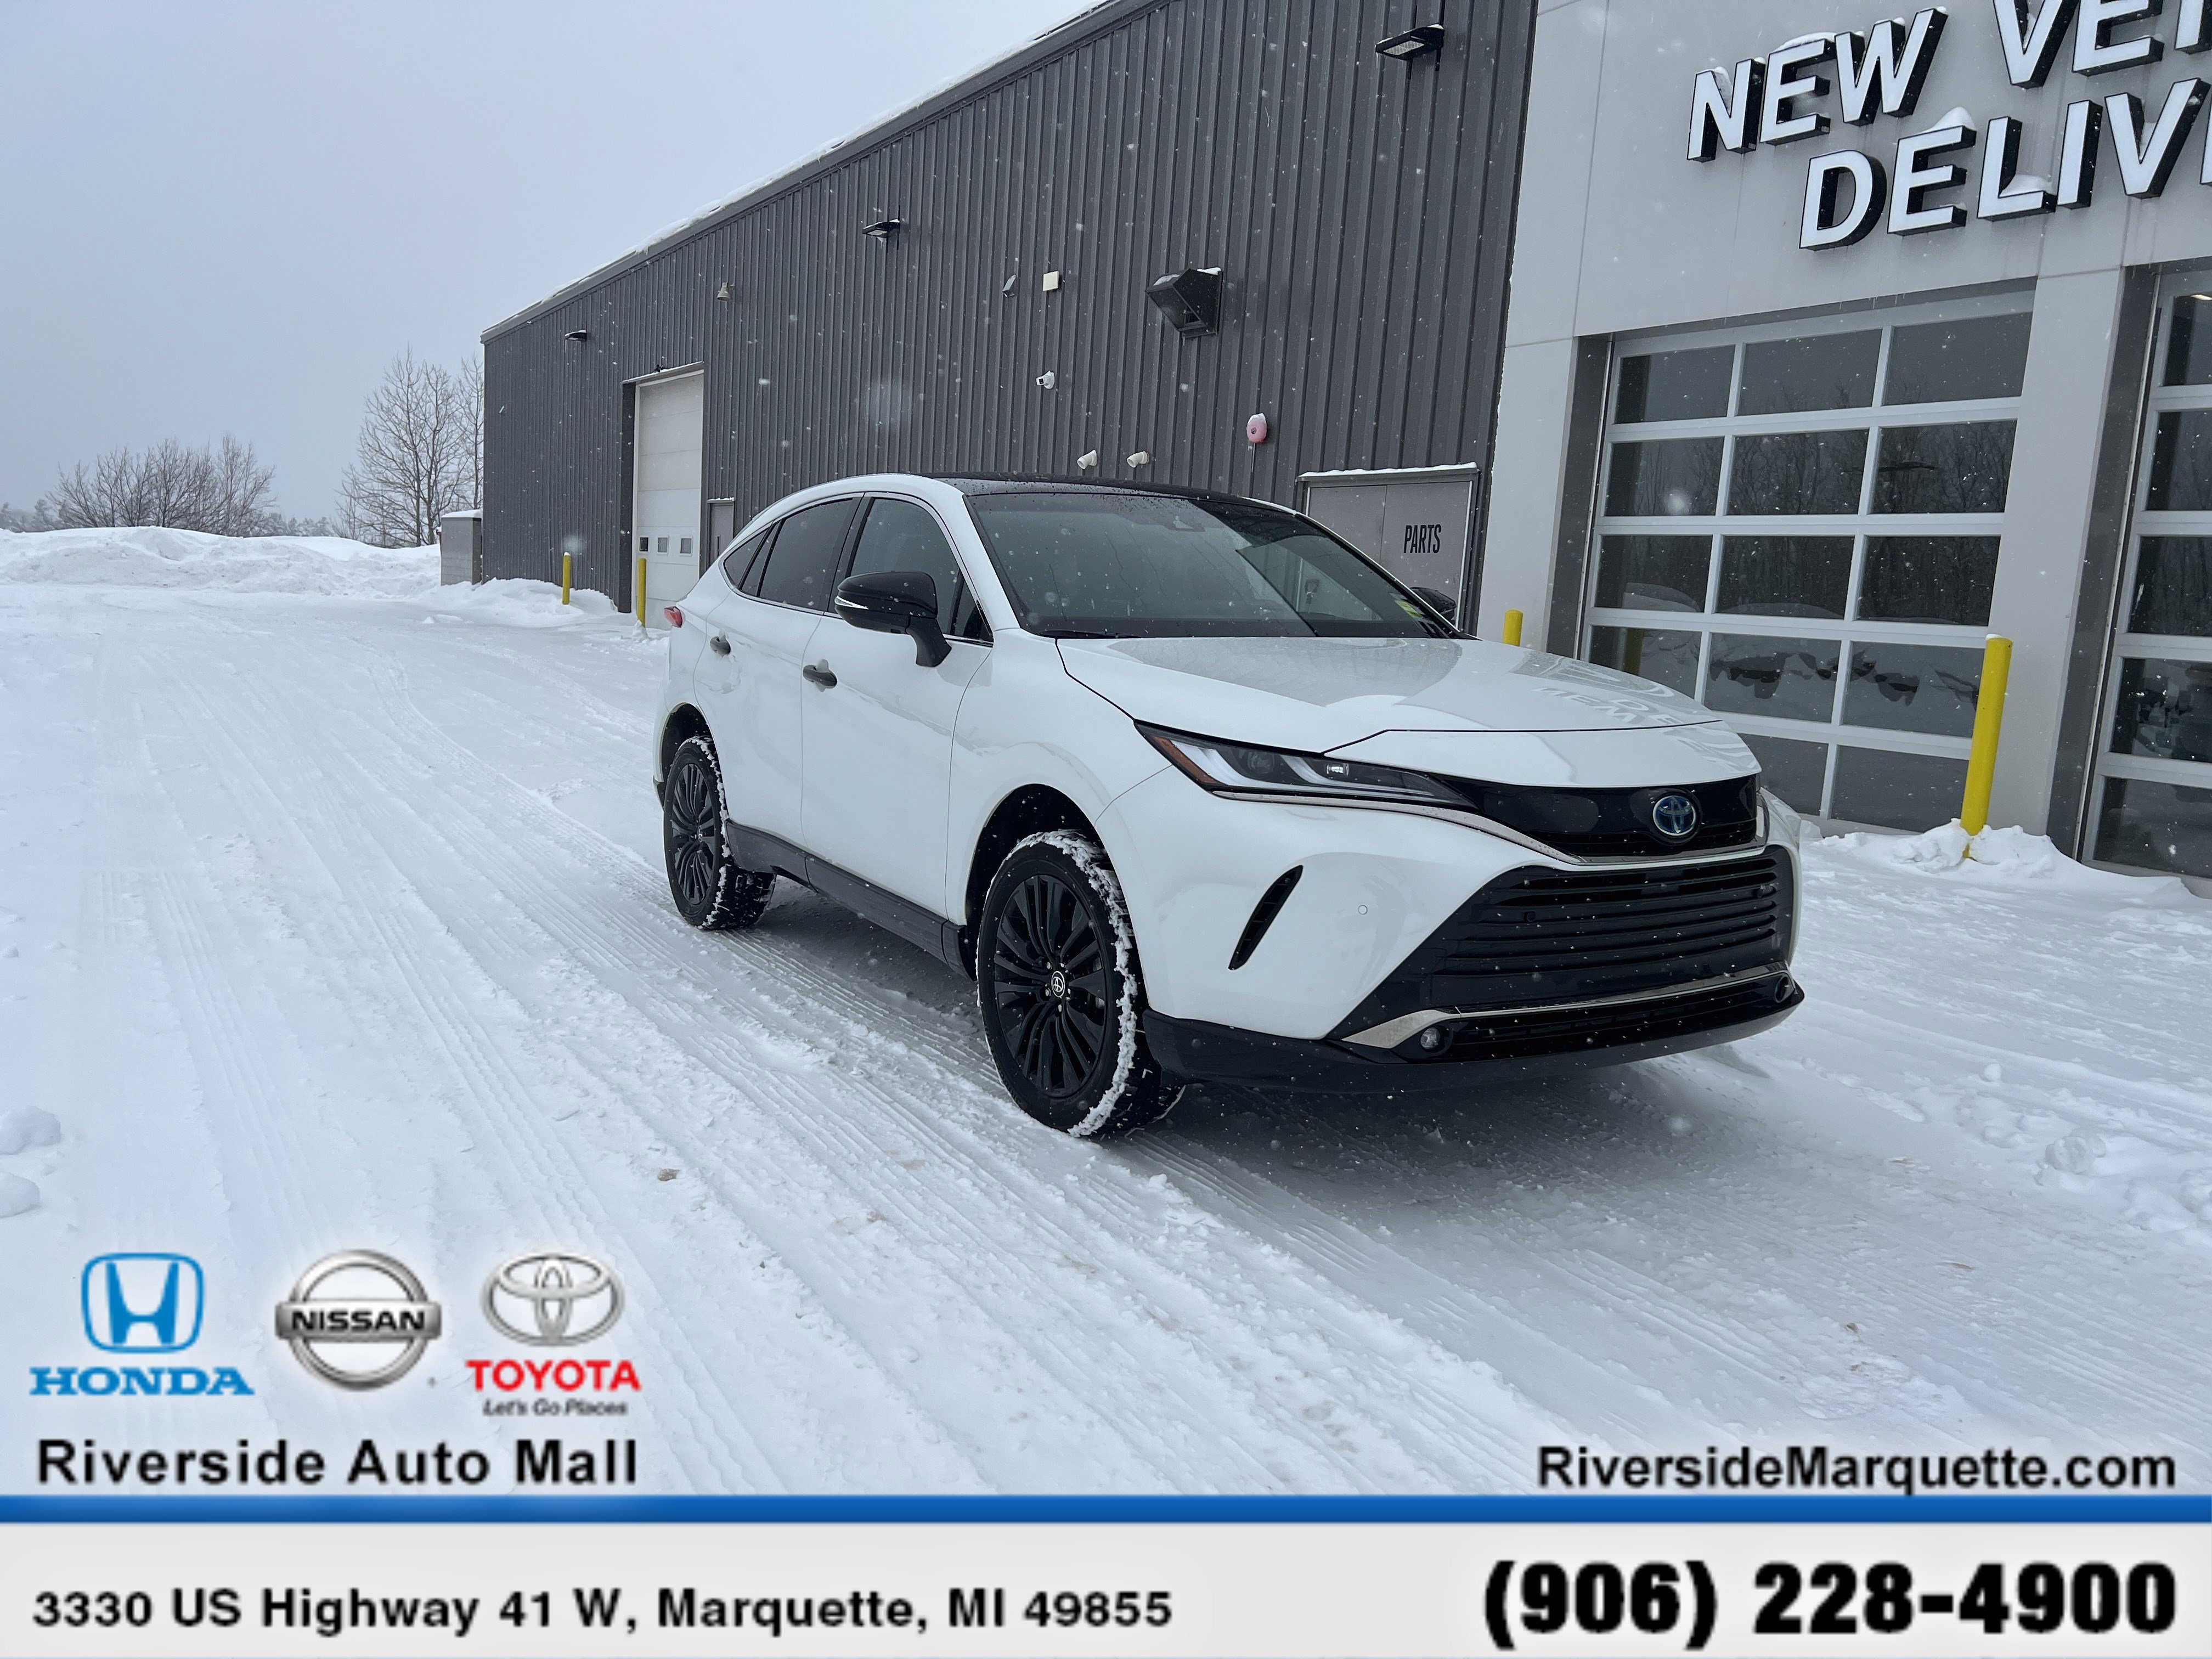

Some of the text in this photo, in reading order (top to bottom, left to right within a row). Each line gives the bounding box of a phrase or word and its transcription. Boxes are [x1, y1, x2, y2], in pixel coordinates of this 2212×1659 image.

[1687, 0, 2212, 162] NEW VE
[1799, 78, 2212, 251] DELIV
[1403, 523, 1442, 554] PARTS
